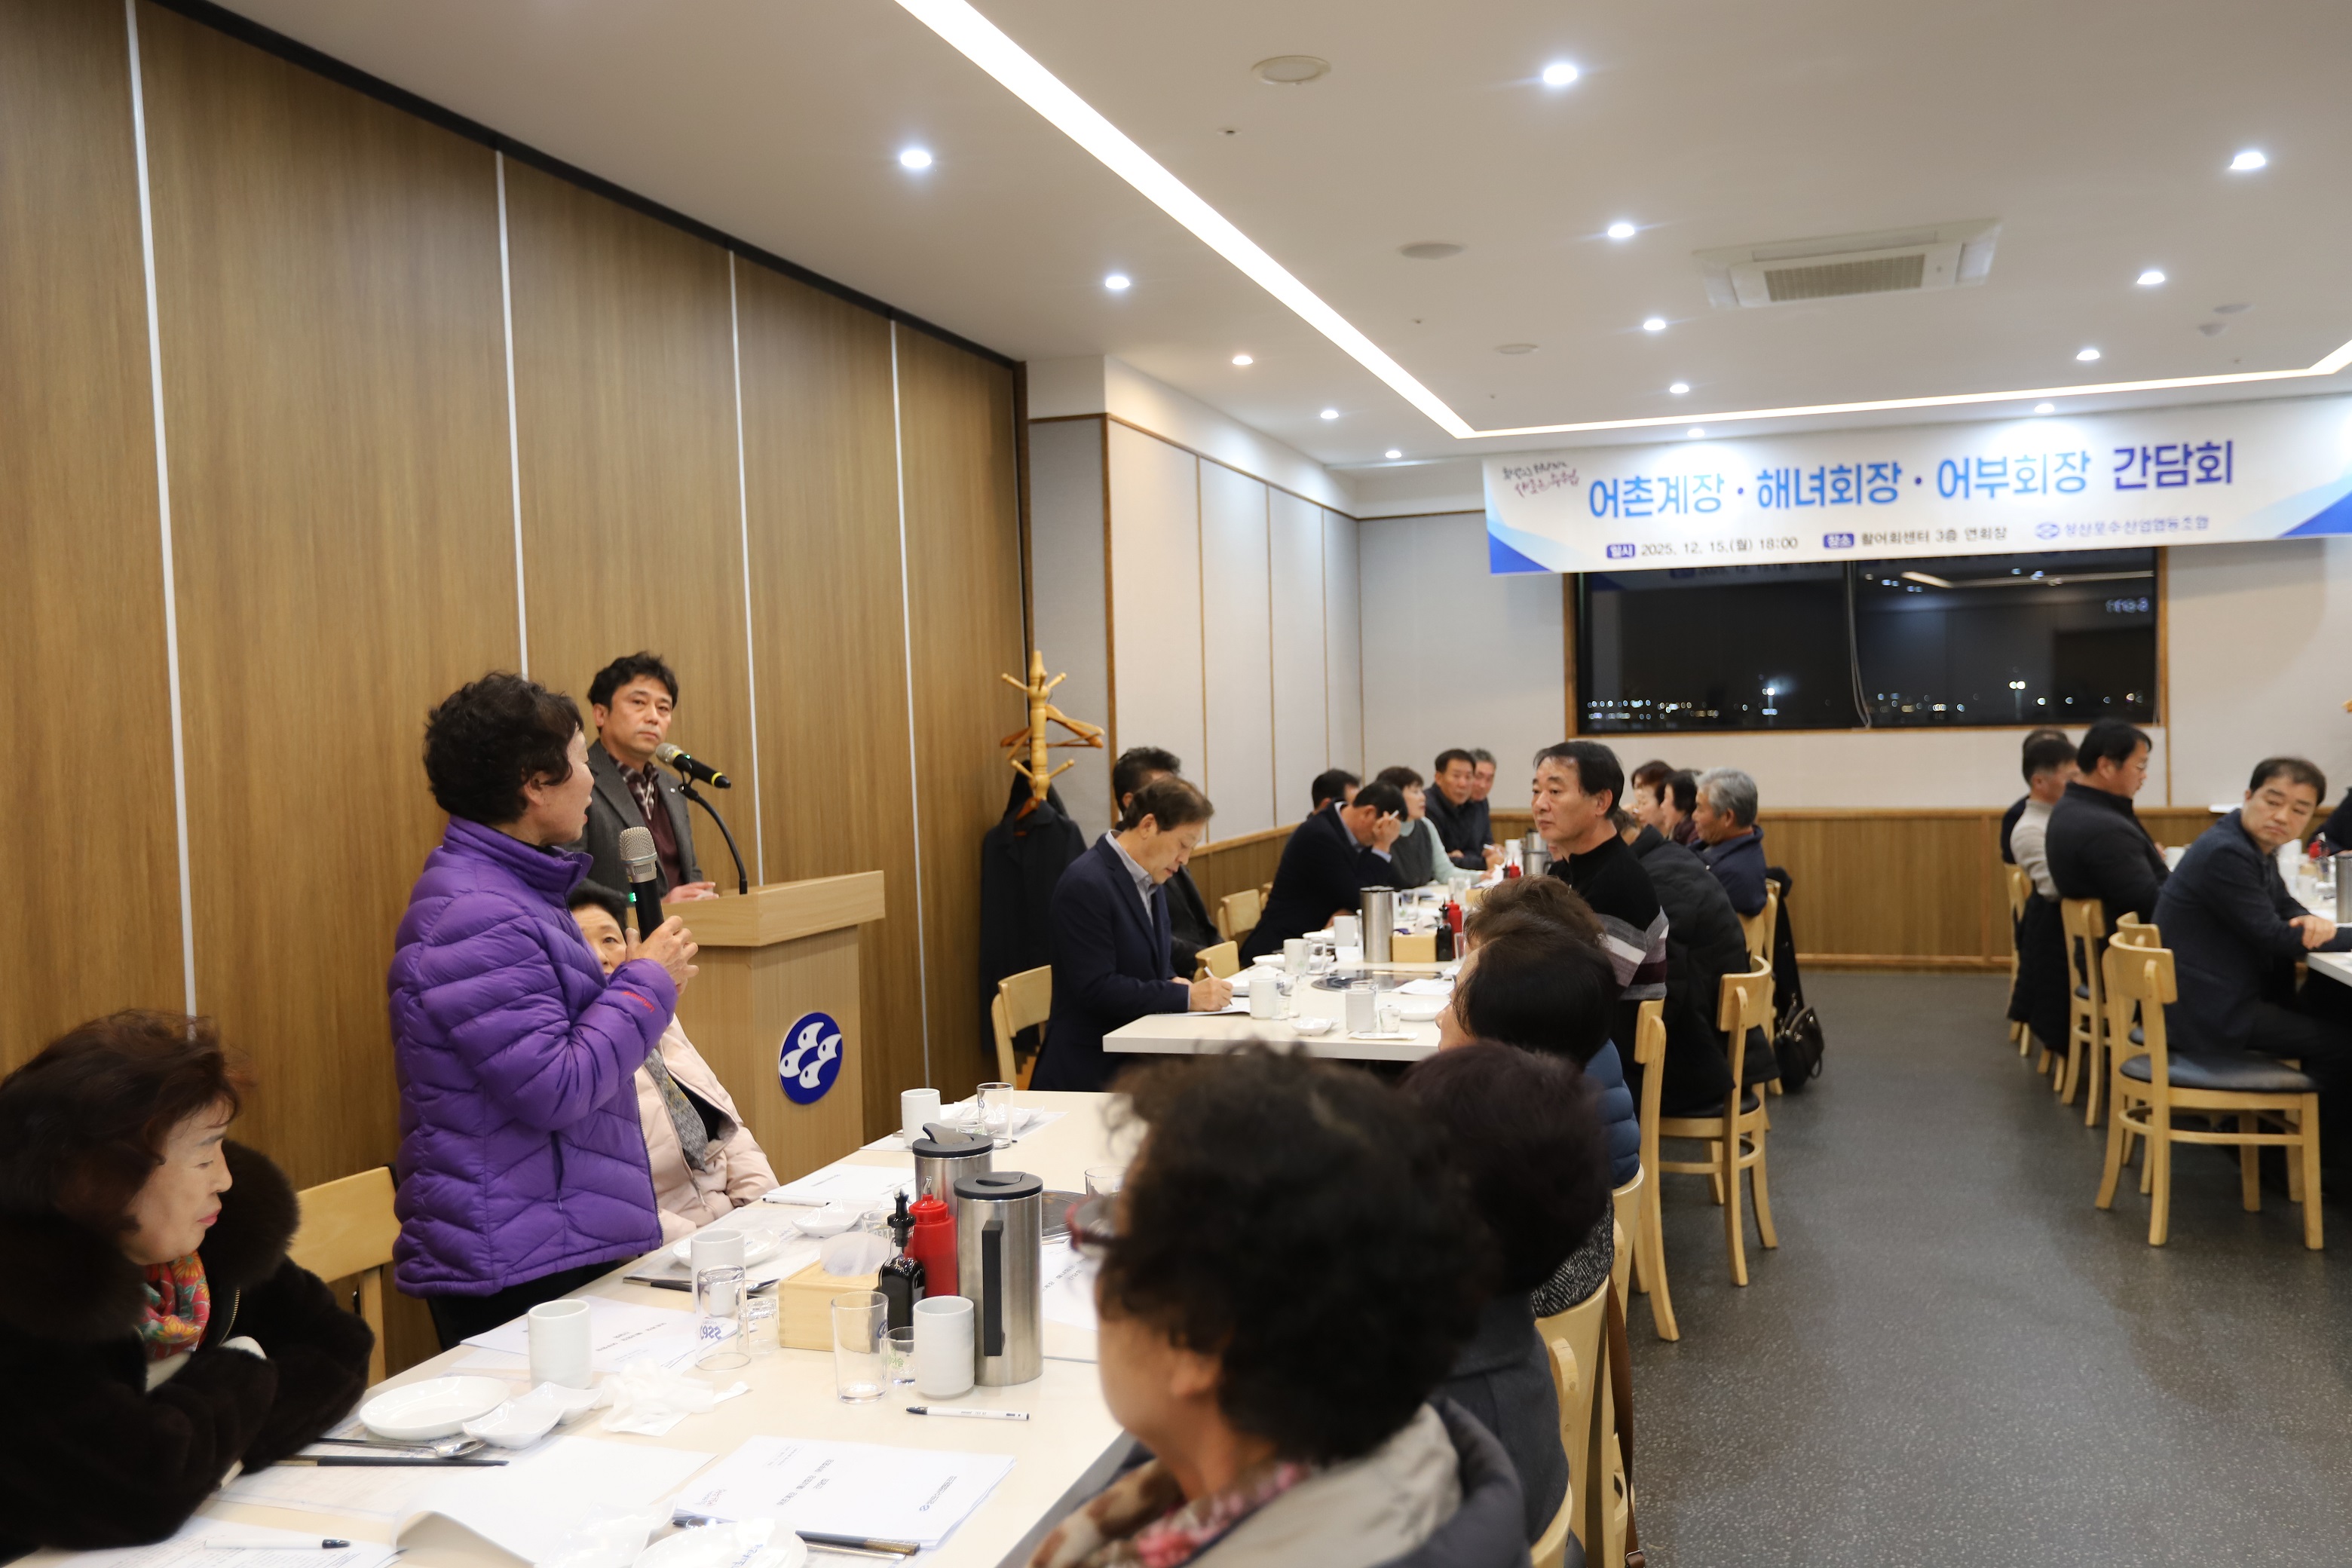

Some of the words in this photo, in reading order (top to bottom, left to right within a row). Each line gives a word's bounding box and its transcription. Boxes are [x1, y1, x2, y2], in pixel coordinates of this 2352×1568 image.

[2113, 439, 2234, 492] 간담회
[1640, 543, 1677, 556] 2025.
[1683, 541, 1703, 555] 12.
[1759, 536, 1799, 550] 18:00
